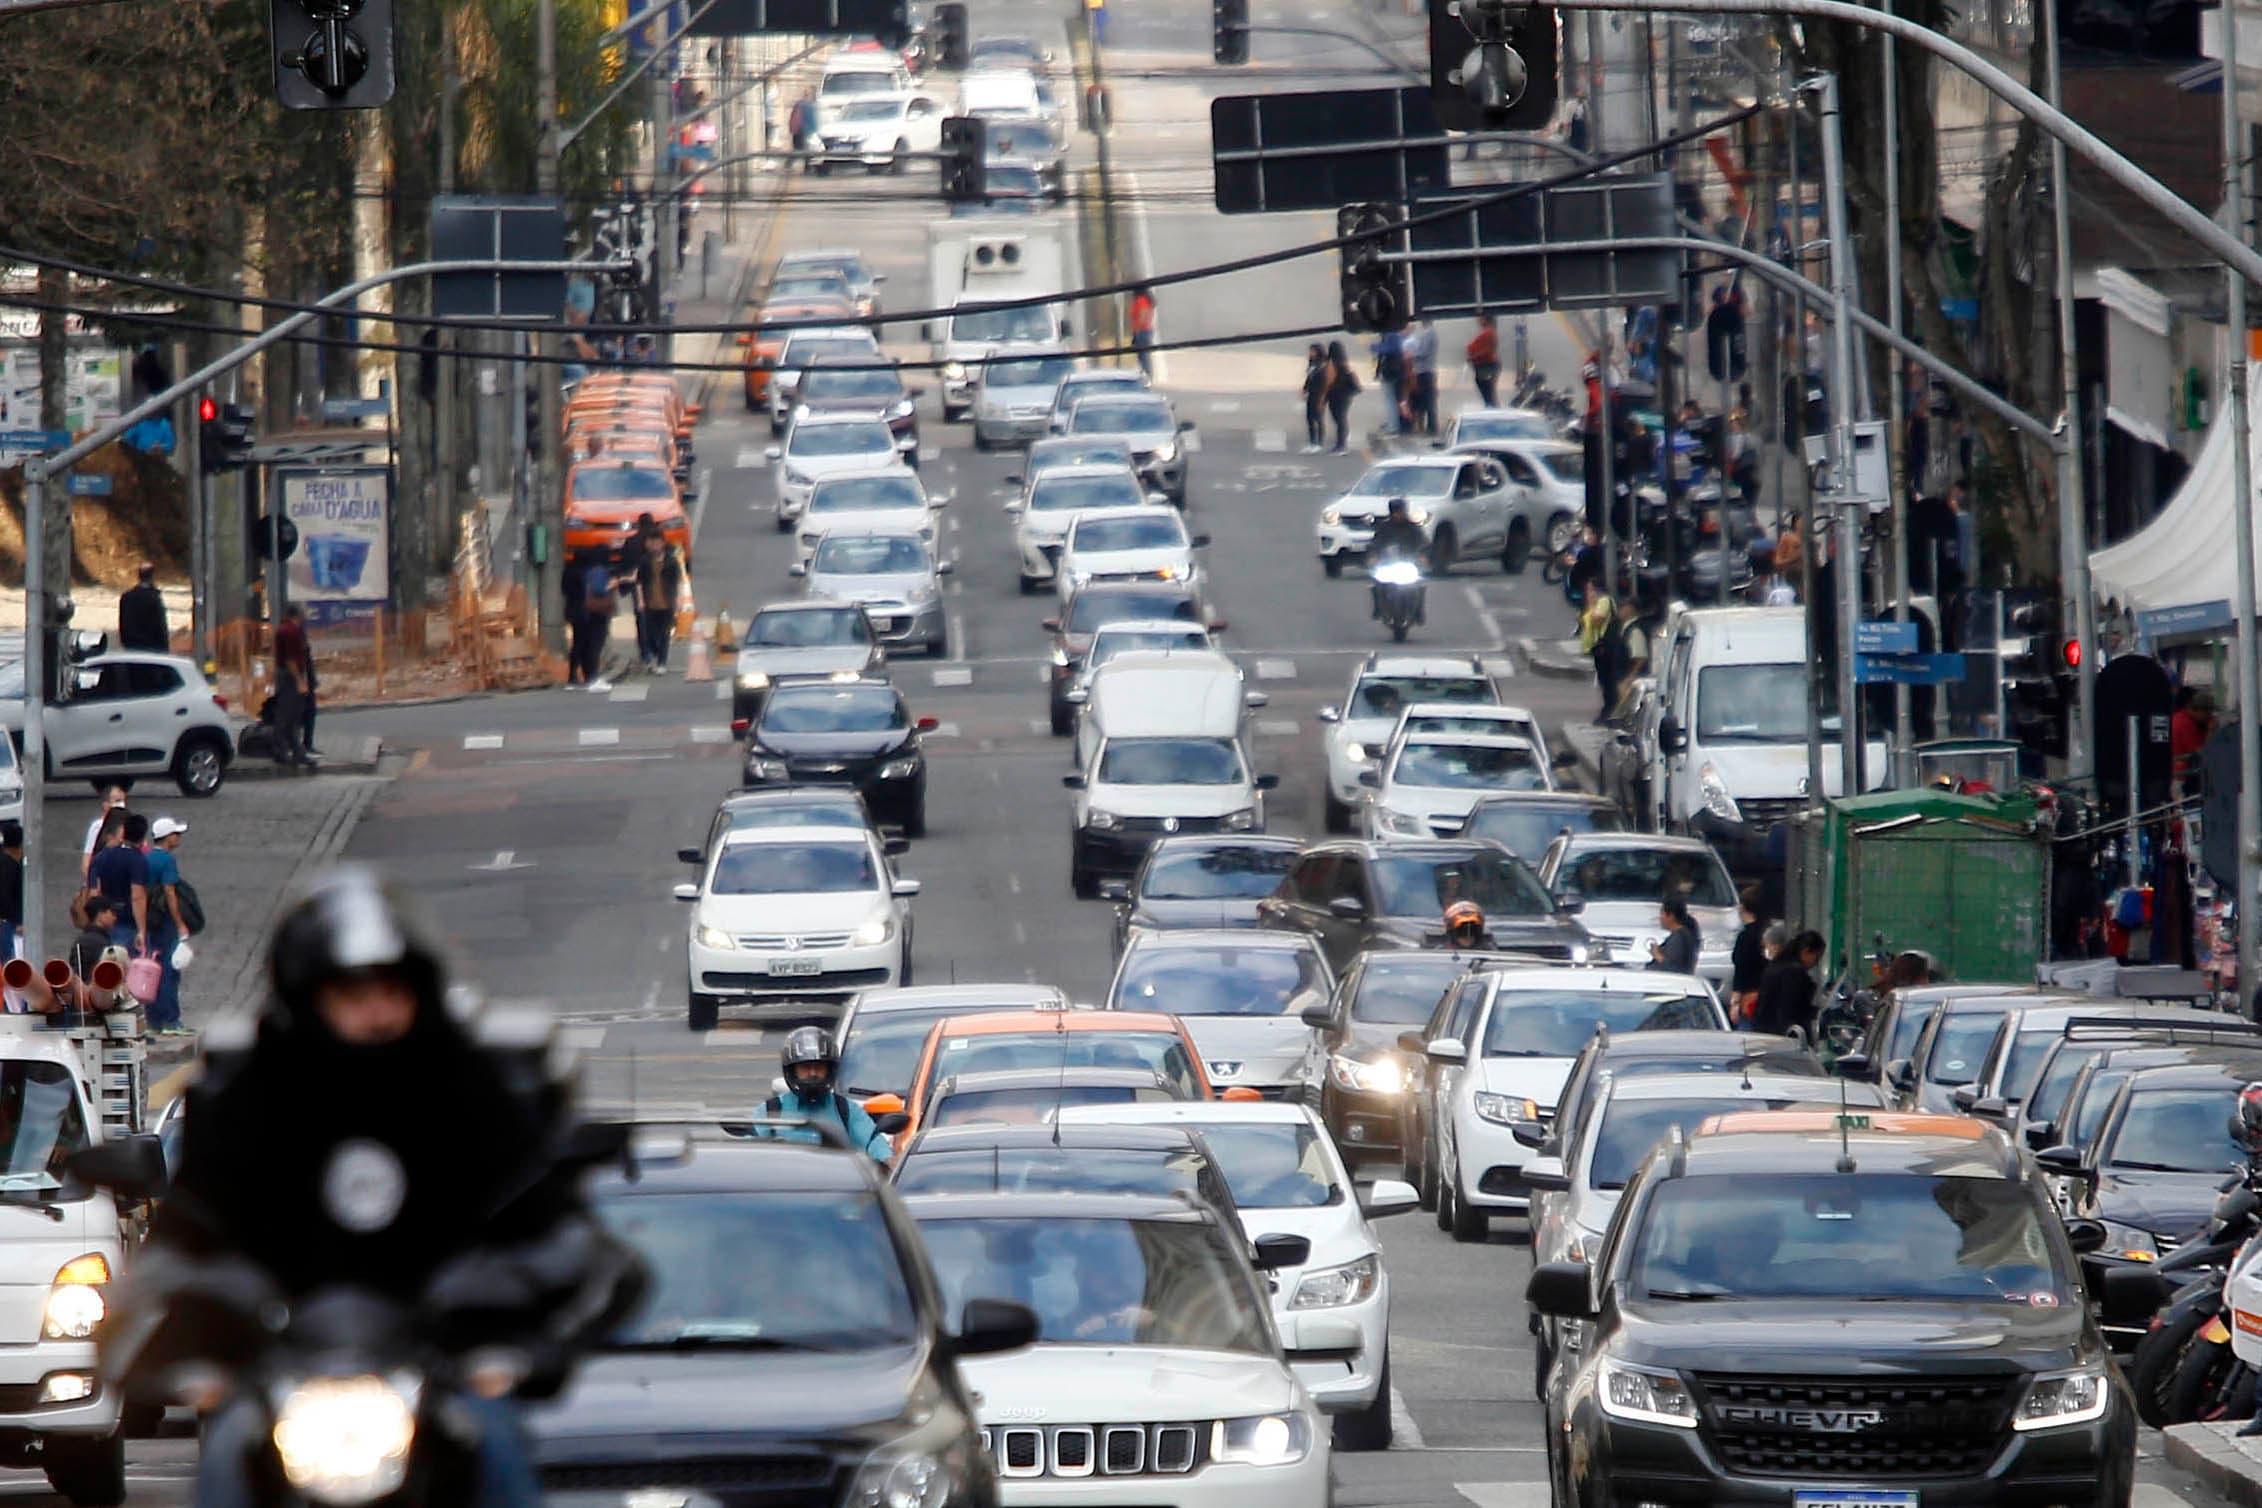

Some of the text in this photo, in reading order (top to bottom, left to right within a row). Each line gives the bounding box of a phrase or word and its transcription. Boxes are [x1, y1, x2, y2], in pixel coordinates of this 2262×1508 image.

[354, 480, 364, 496] A
[1836, 1115, 1869, 1129] TAXI
[1725, 1406, 1882, 1431] CHEVR
